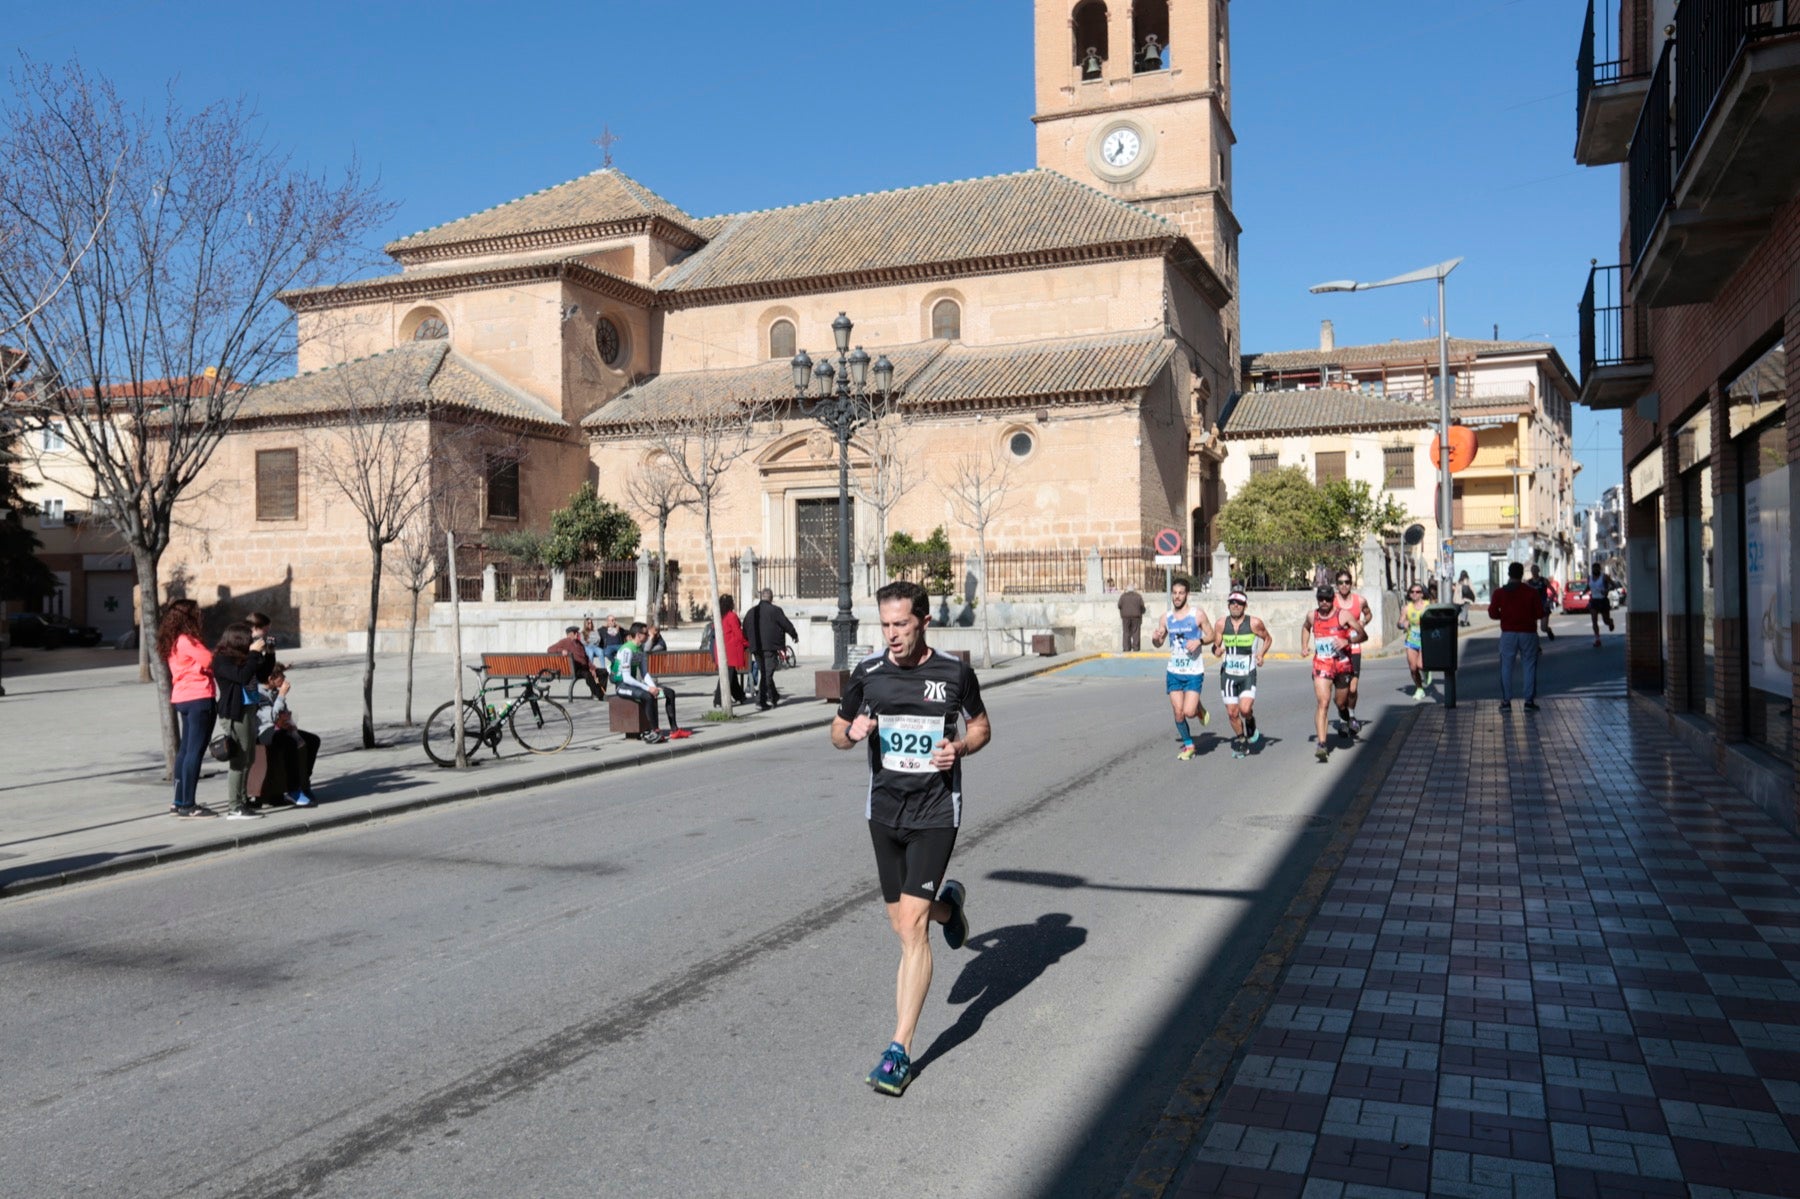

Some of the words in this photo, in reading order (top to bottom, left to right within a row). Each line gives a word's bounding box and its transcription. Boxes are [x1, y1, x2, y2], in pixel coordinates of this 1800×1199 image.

[1175, 658, 1191, 667] 557
[1228, 660, 1246, 669] 346
[890, 732, 932, 755] 929
